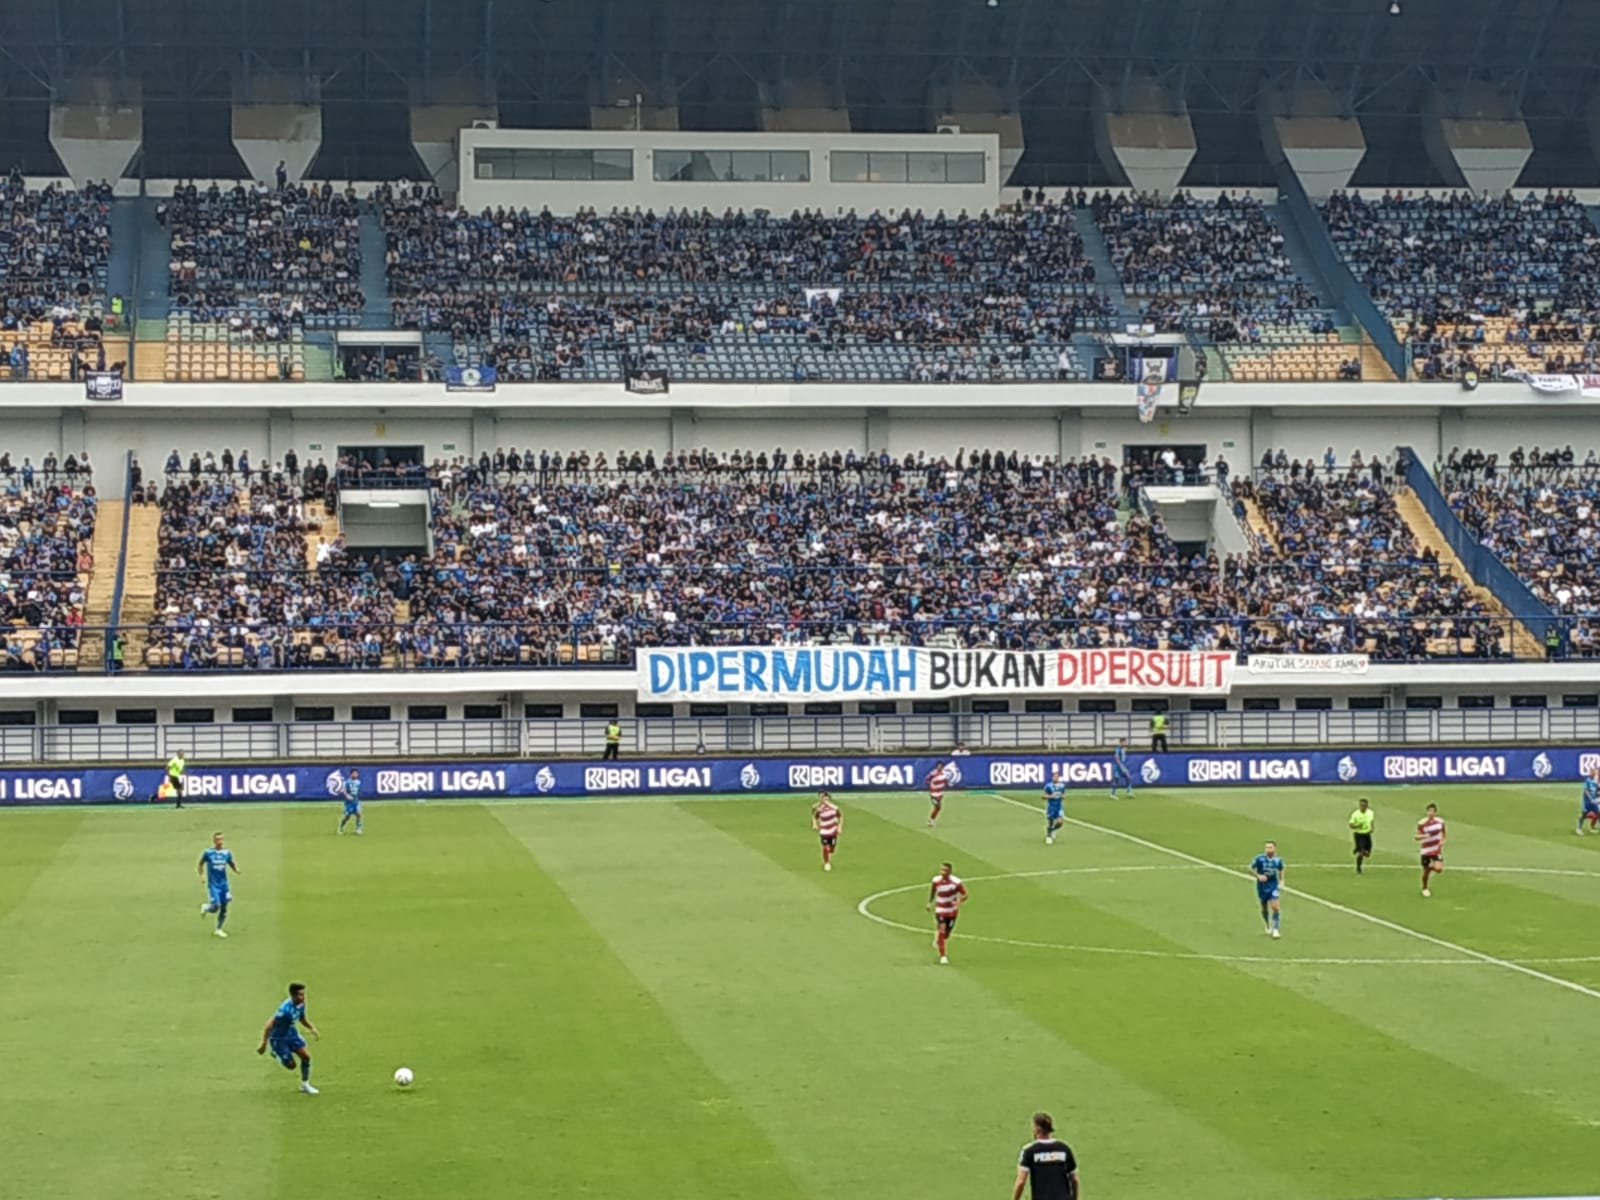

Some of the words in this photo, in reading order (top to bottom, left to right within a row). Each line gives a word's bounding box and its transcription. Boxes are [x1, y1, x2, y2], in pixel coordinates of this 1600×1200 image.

[650, 648, 916, 693] DIPERMUDAH
[929, 651, 1045, 690] BUKAN
[1057, 651, 1231, 687] DIPERSULIT
[811, 766, 843, 785] BRI
[852, 765, 914, 785] LIGA1
[1012, 763, 1045, 782] BRI
[1052, 762, 1112, 781] LIGA1
[1209, 760, 1241, 779] BRI
[1249, 760, 1310, 779] LIGA1
[1406, 757, 1437, 777] BRI
[1445, 757, 1505, 776] LIGA1
[15, 778, 82, 798] LIGA1
[191, 776, 222, 796] BRI
[231, 774, 296, 794] LIGA1
[400, 771, 434, 791] BRI
[442, 770, 505, 791] LIGA1
[607, 769, 640, 788] BRI
[648, 768, 711, 787] LIGA1
